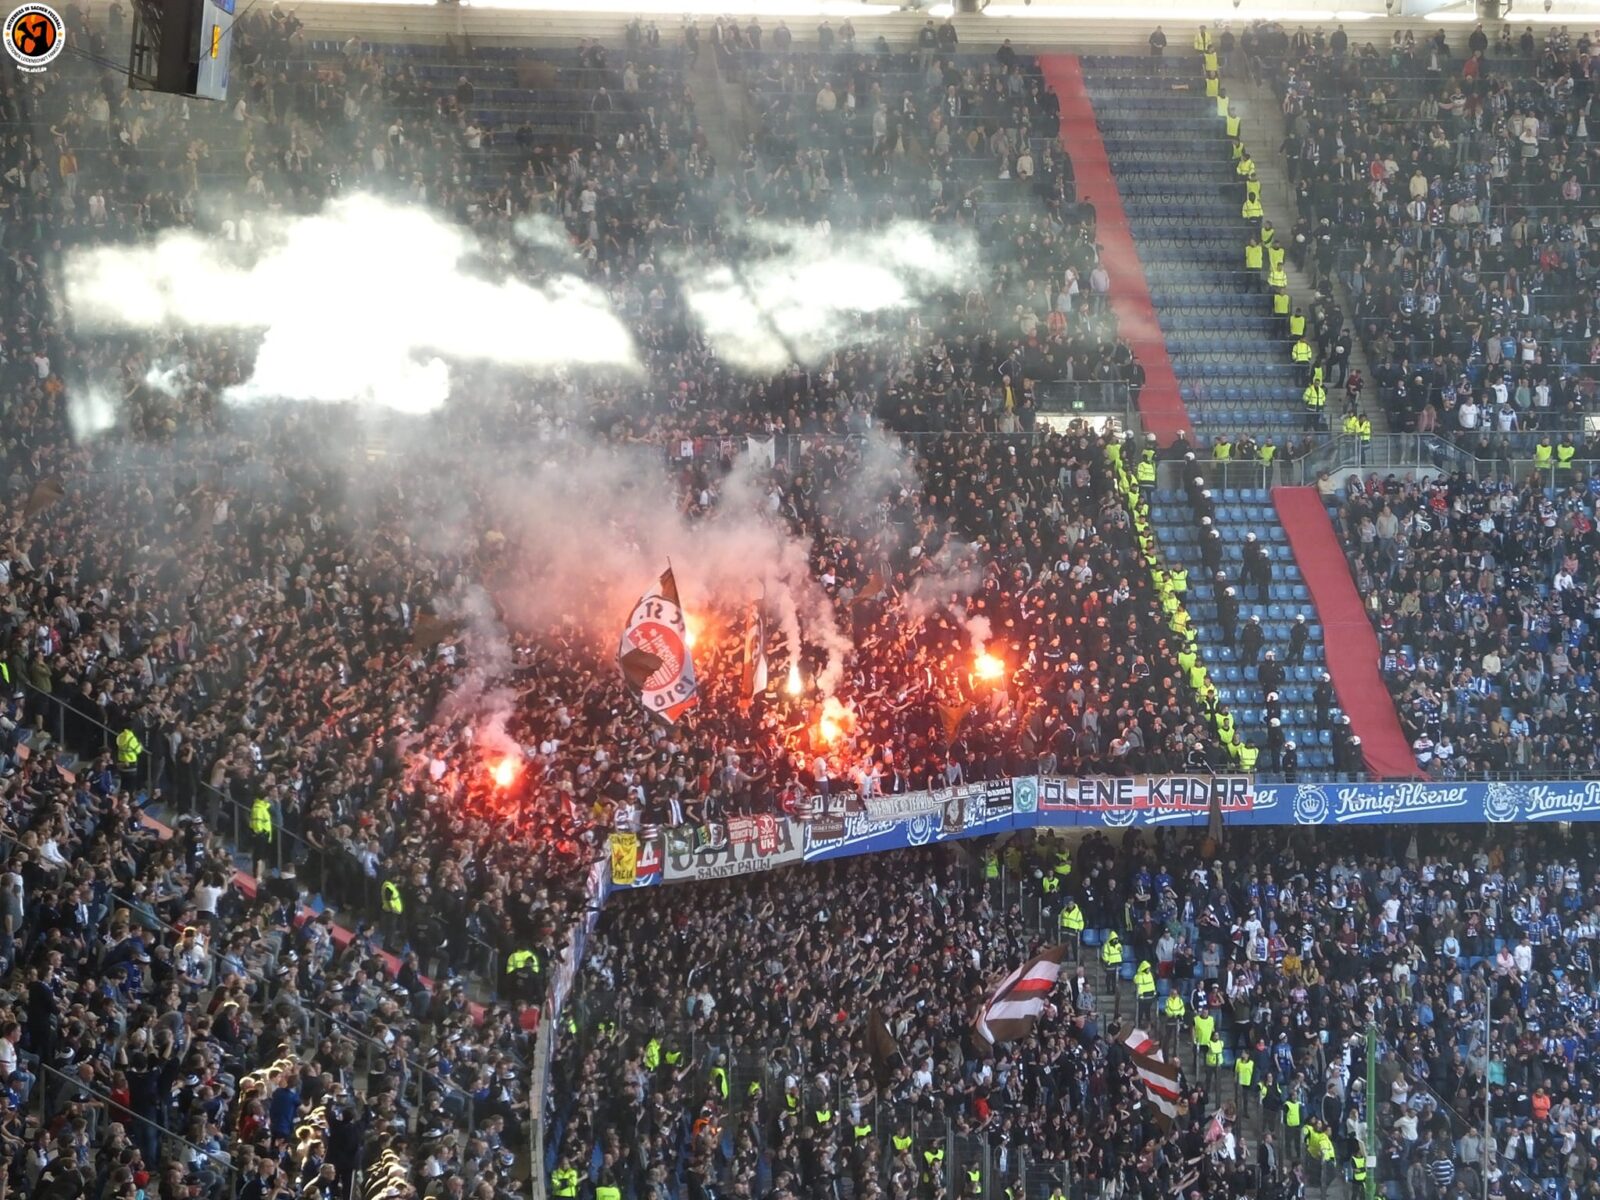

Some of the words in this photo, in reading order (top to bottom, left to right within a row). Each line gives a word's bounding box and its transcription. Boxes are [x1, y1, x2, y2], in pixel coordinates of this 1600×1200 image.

[1147, 777, 1249, 806] KADAR
[1525, 785, 1584, 813] König
[697, 863, 735, 879] SANKT
[737, 858, 771, 873] PAULI
